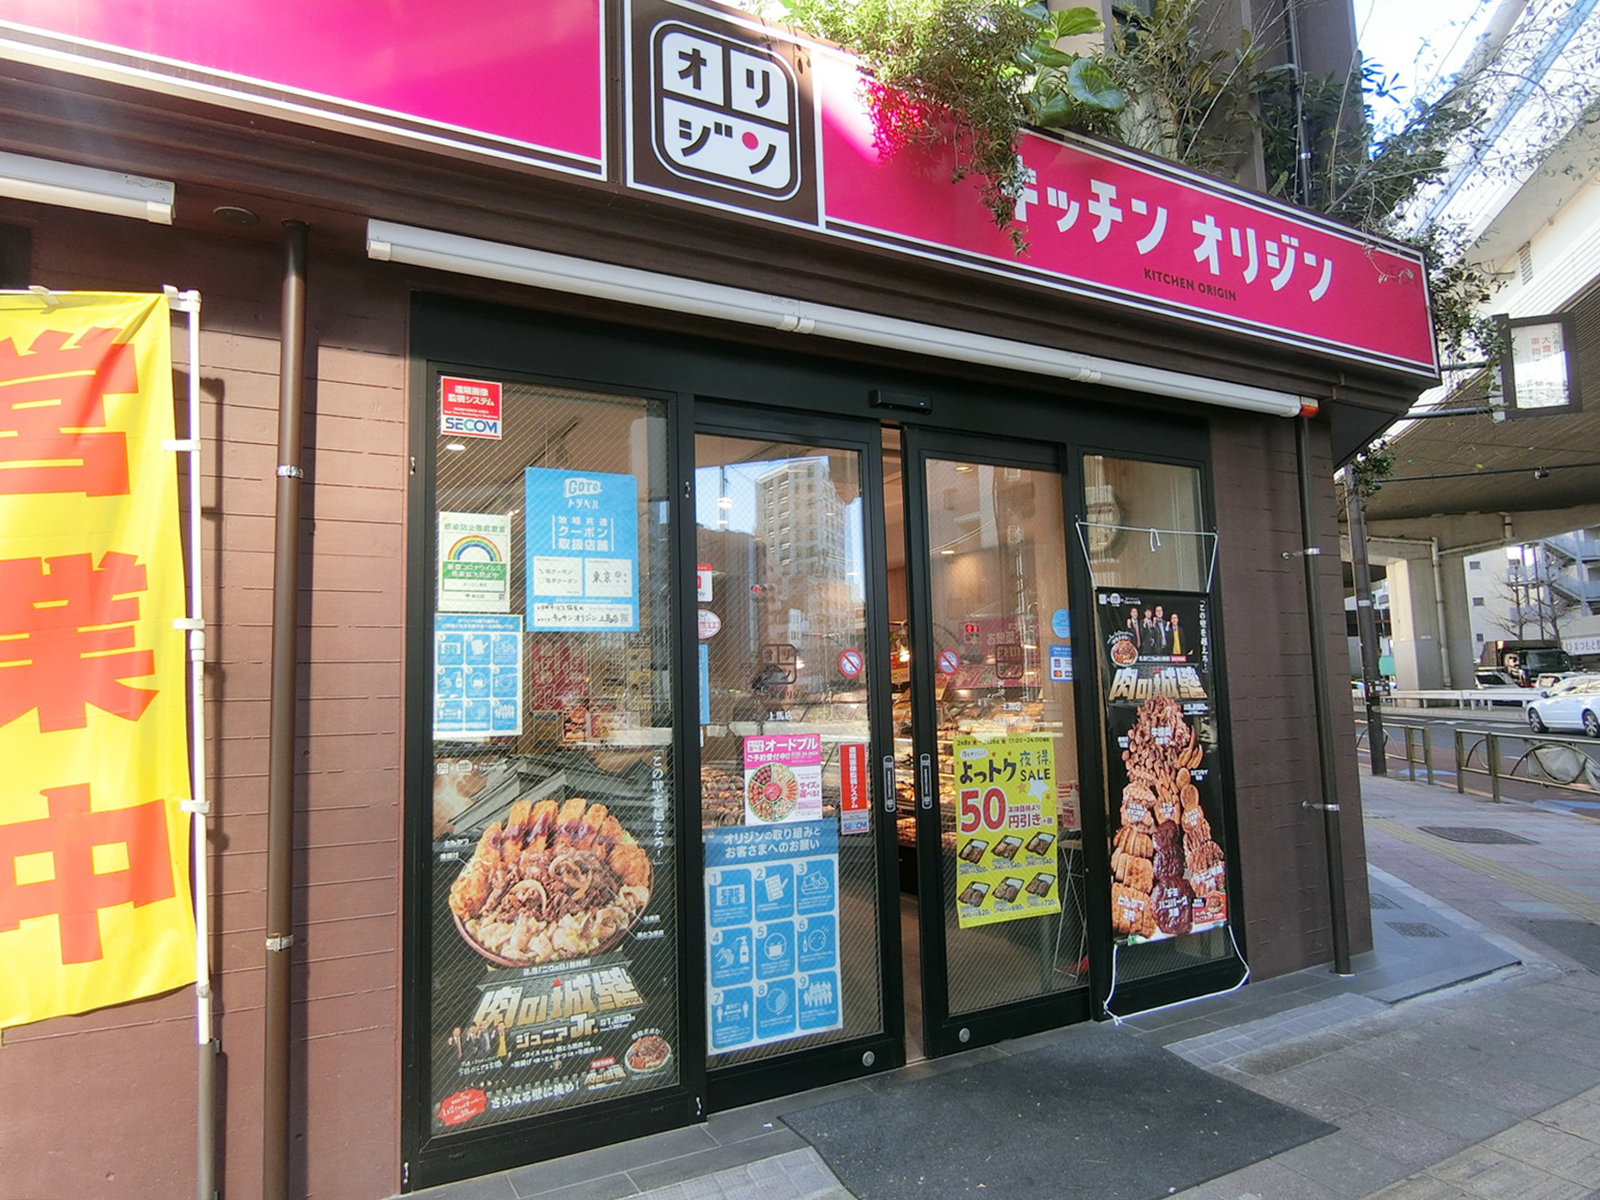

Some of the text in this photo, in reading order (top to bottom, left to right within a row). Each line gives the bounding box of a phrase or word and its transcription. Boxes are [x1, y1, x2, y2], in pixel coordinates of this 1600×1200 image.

[1192, 214, 1333, 302] オリジン
[1143, 268, 1237, 302] KITCHEN ORIGIN
[446, 417, 498, 433] SECOM
[568, 499, 599, 509] トラベル
[558, 516, 608, 526] 地域共通
[559, 526, 608, 538] クーポン
[558, 538, 609, 551] 取扱店舗
[0, 326, 175, 965] 営業中
[769, 711, 792, 720] 上馬店
[765, 738, 818, 752] オードブル
[960, 758, 1017, 784] よっトク
[1020, 768, 1051, 782] SALE
[960, 787, 1006, 832] 50
[1008, 813, 1041, 829] 円引き
[724, 826, 821, 845] オリジンの取り組みと
[725, 839, 820, 858] お客さまへのお願い
[516, 1027, 568, 1049] ジュニア
[570, 1013, 600, 1038] Jr.
